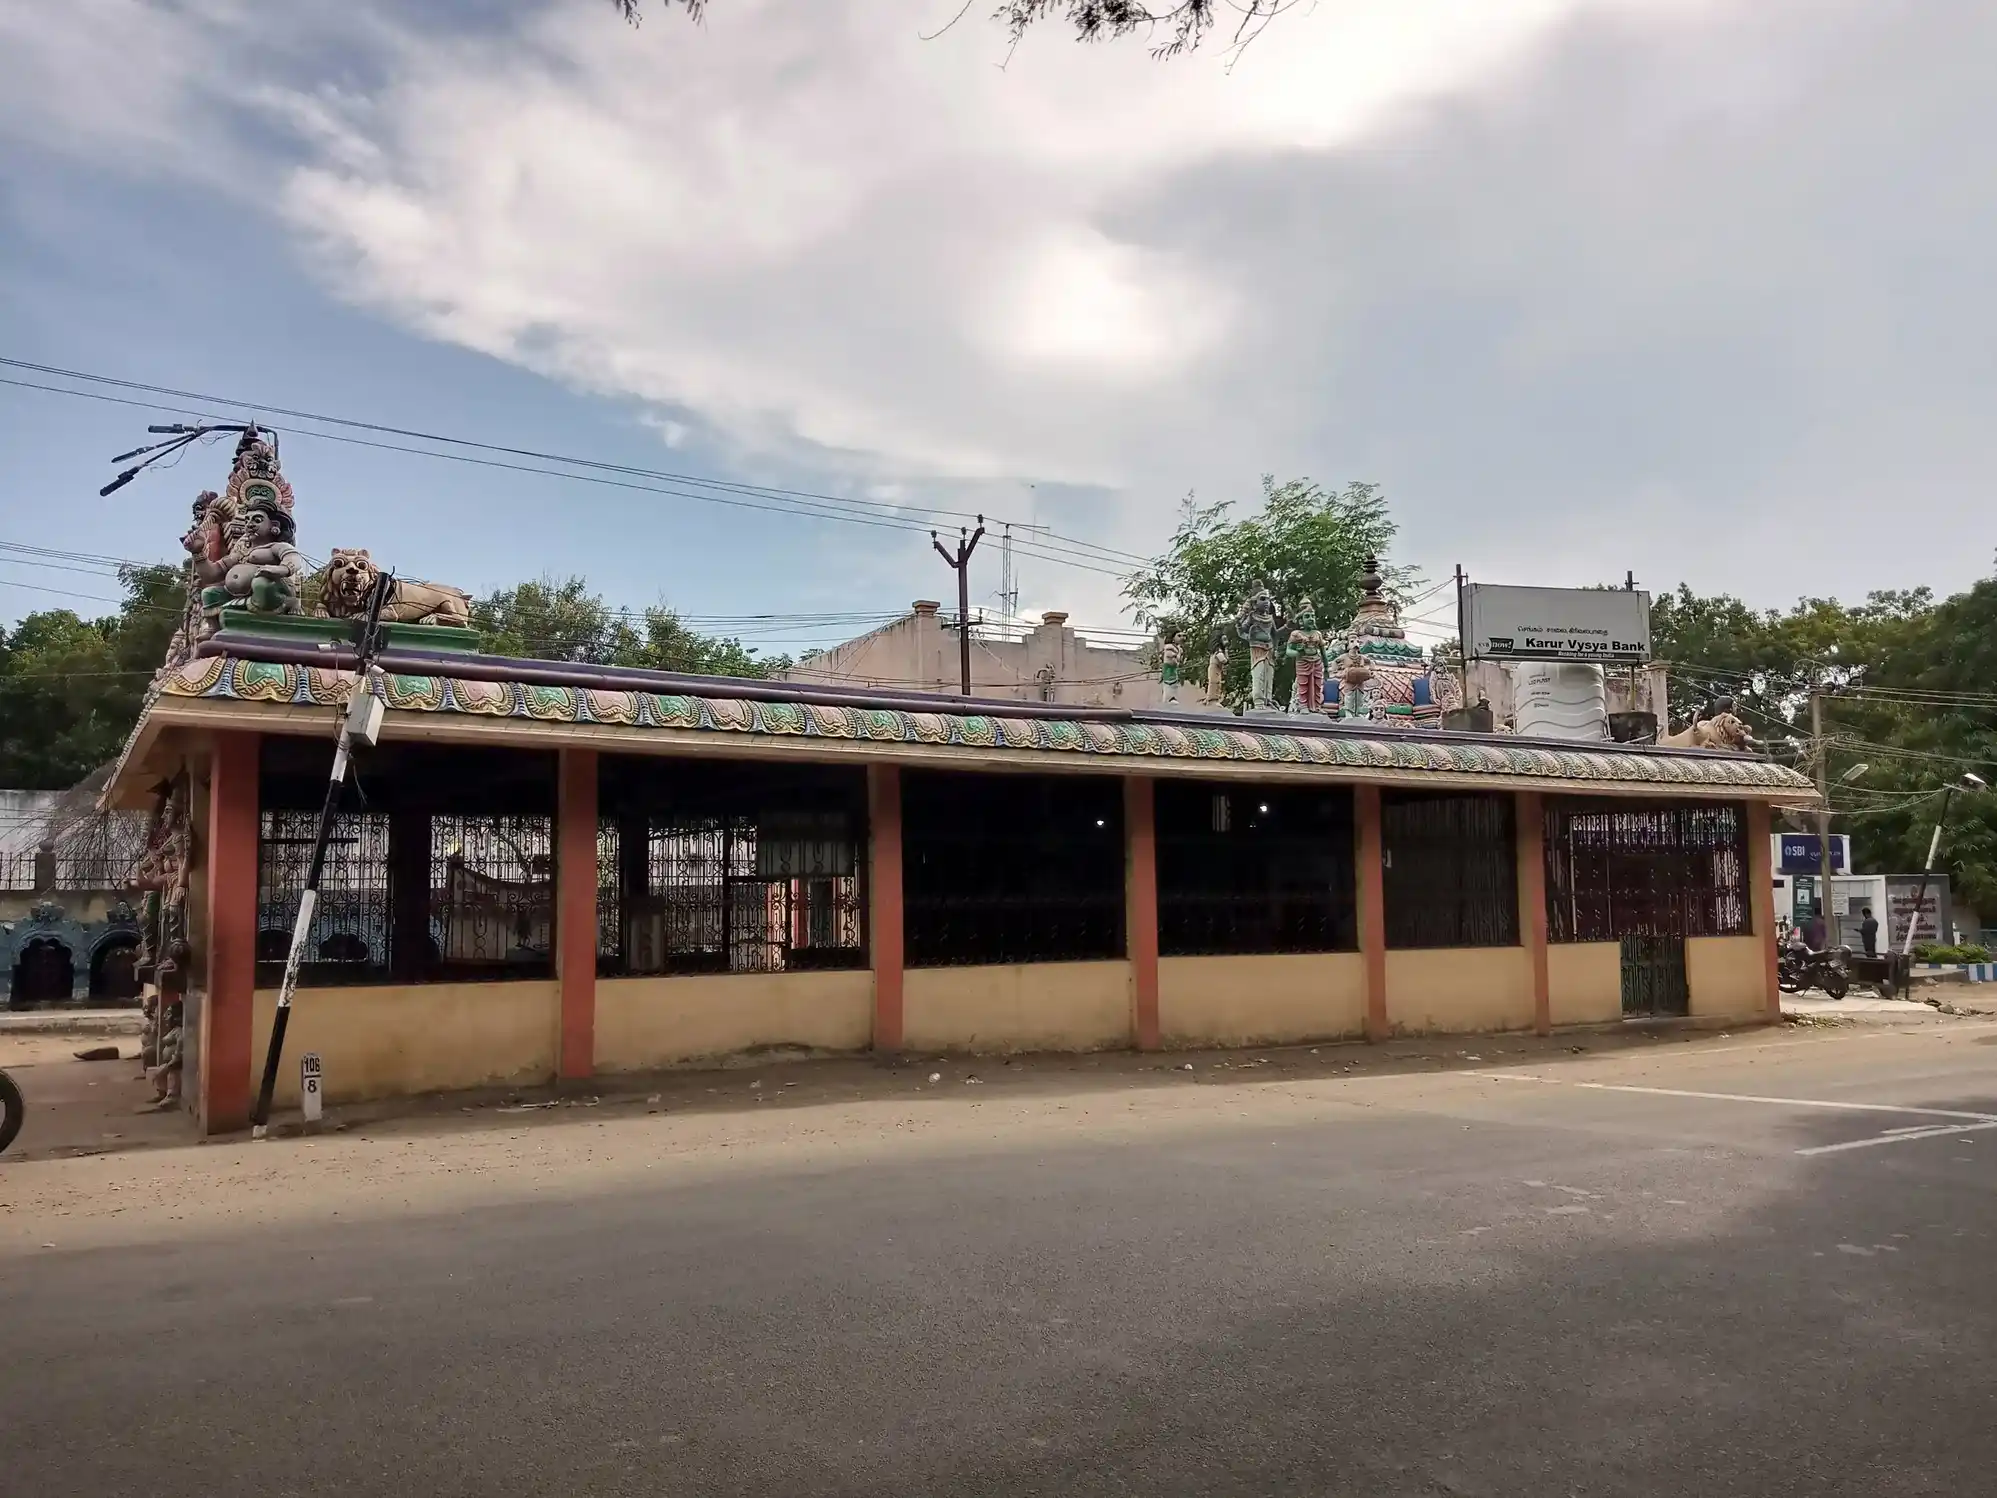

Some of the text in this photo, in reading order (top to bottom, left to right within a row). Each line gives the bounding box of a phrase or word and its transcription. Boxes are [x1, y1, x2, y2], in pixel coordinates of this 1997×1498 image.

[1492, 641, 1512, 649] now!
[1526, 638, 1645, 652] Karur Vysya Bank
[1792, 845, 1806, 856] SBI
[304, 1056, 321, 1072] 106
[307, 1079, 317, 1093] 8
